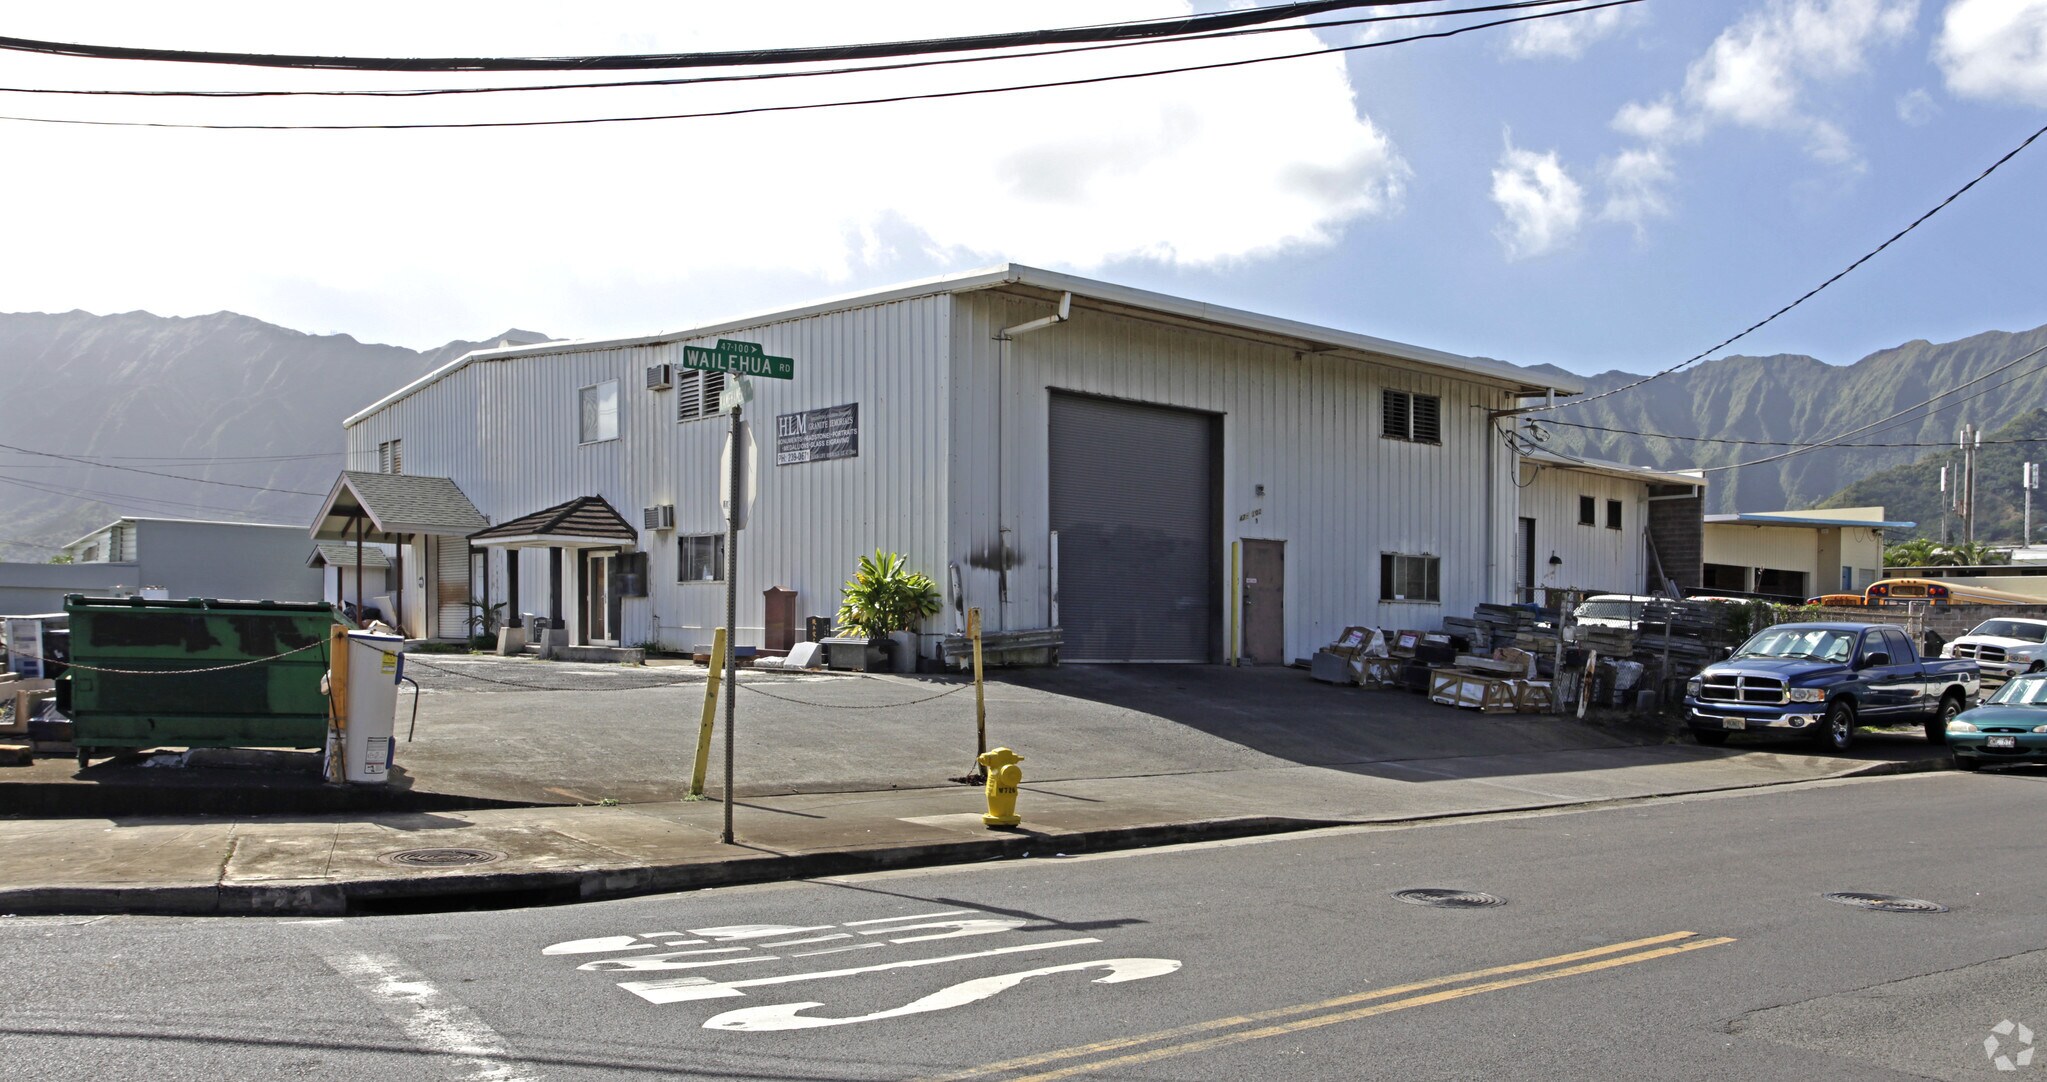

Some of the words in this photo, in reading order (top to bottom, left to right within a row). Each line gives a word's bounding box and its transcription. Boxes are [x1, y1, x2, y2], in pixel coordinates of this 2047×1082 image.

[721, 342, 749, 353] 47-100
[686, 350, 772, 374] WAILEHUA
[779, 363, 791, 373] RD
[779, 413, 807, 437] HLM
[543, 911, 1181, 1031] STOP
